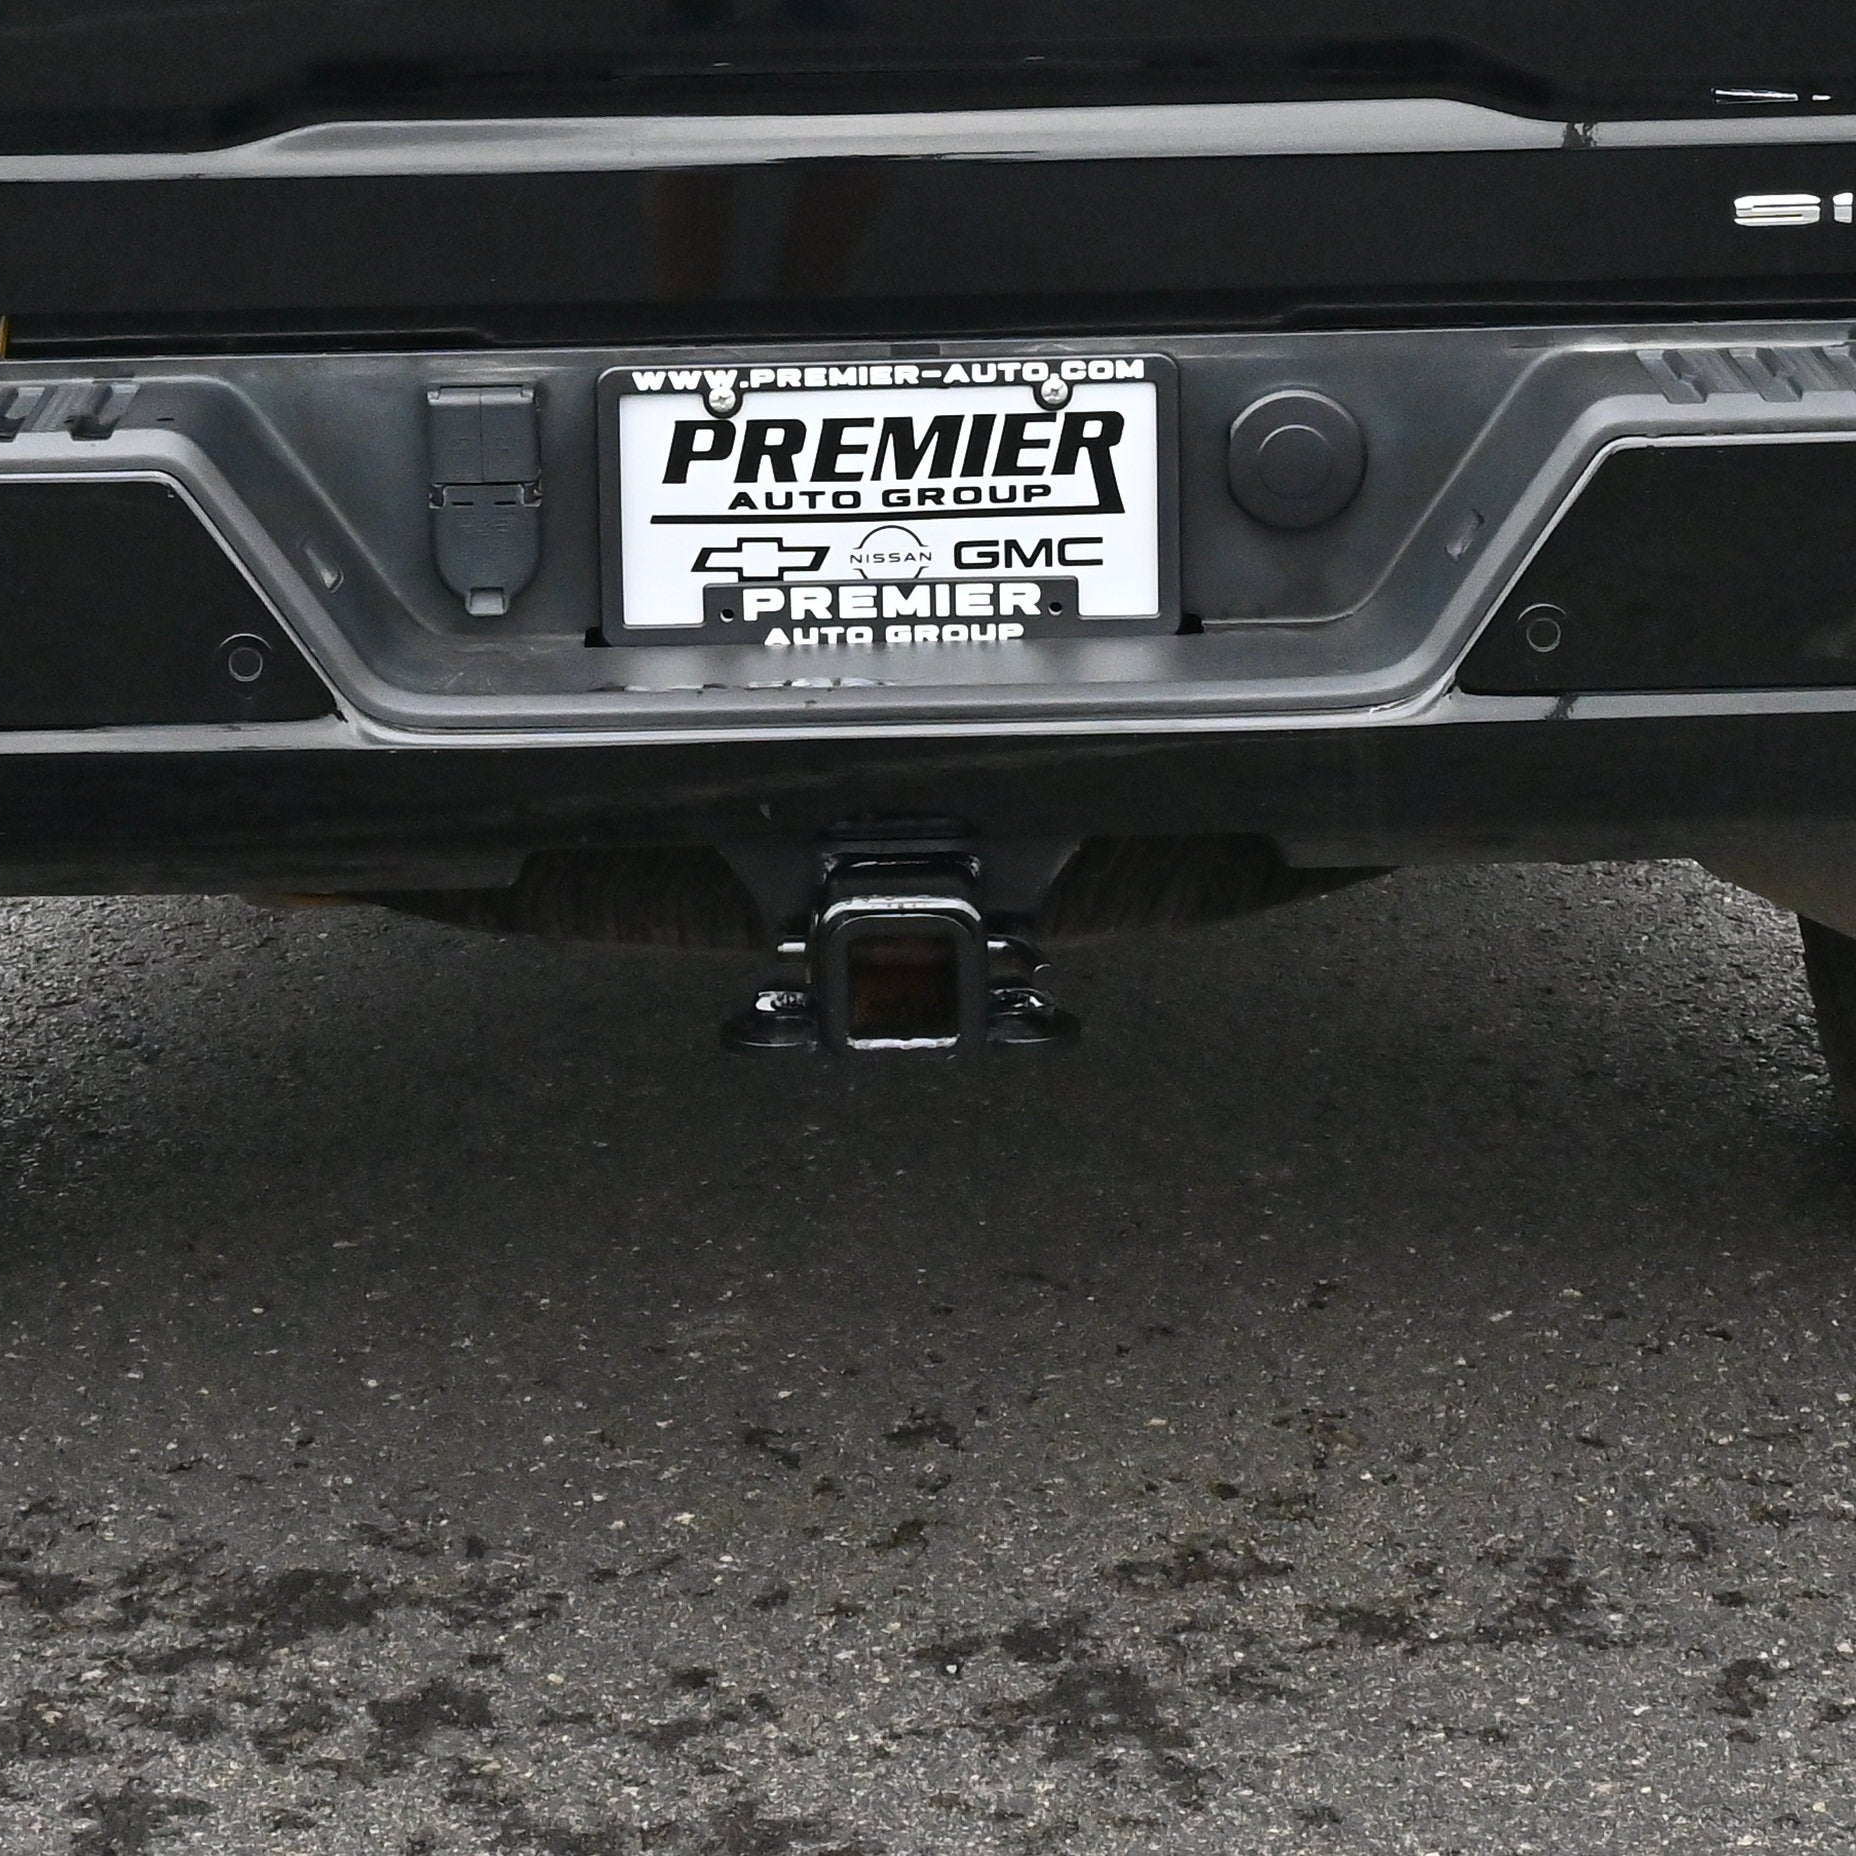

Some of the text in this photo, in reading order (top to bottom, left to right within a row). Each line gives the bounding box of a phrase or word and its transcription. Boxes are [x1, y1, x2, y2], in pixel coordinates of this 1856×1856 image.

[632, 359, 1145, 391] WWW.PREMIER-AUTO.COM
[662, 411, 1125, 513] PREMIER
[728, 484, 1052, 510] AUTO GROUP
[850, 551, 932, 564] NISSAN
[954, 537, 1103, 570] GMC
[742, 582, 1042, 622] PREMIER
[764, 623, 1025, 646] AUTO GROUP
